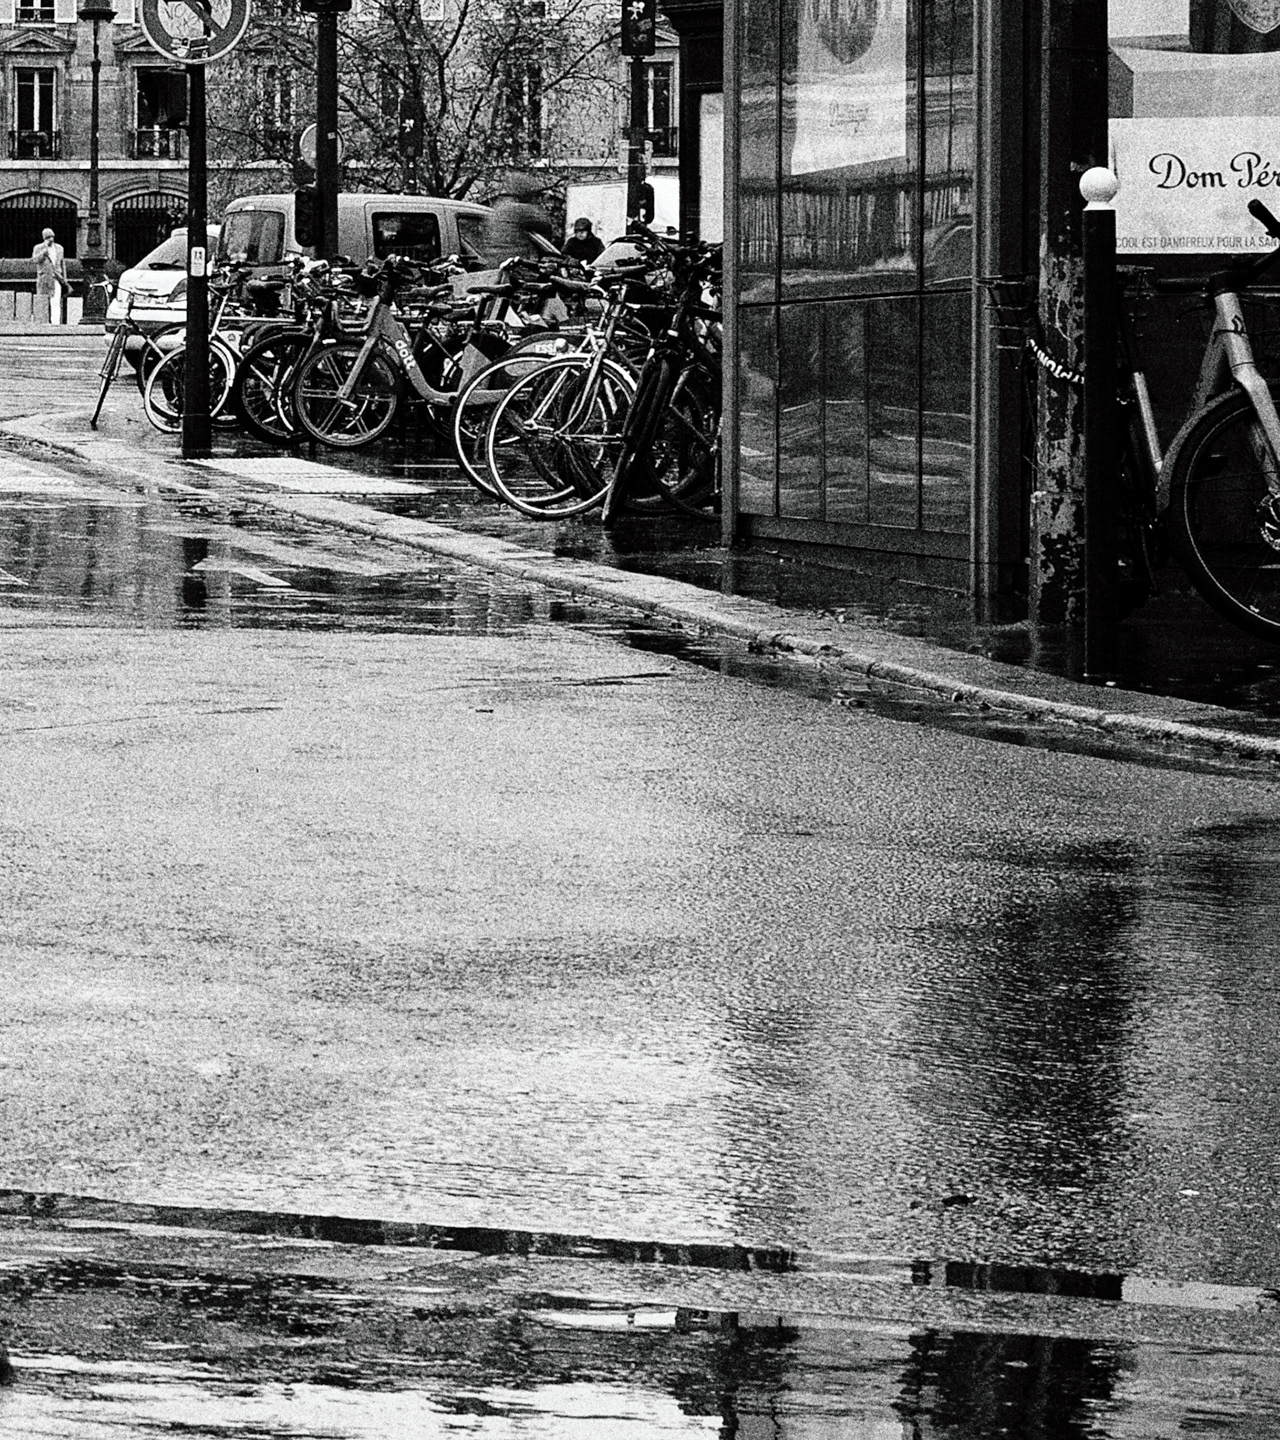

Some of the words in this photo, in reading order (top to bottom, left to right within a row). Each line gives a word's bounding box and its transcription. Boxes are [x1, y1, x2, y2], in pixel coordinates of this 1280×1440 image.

[1149, 153, 1227, 189] Dom
[1230, 152, 1280, 189] Pér
[1142, 237, 1157, 248] EST
[1160, 237, 1214, 248] DANGEREUX
[1217, 236, 1243, 248] POUR
[1245, 236, 1256, 247] LA
[395, 340, 416, 370] dott
